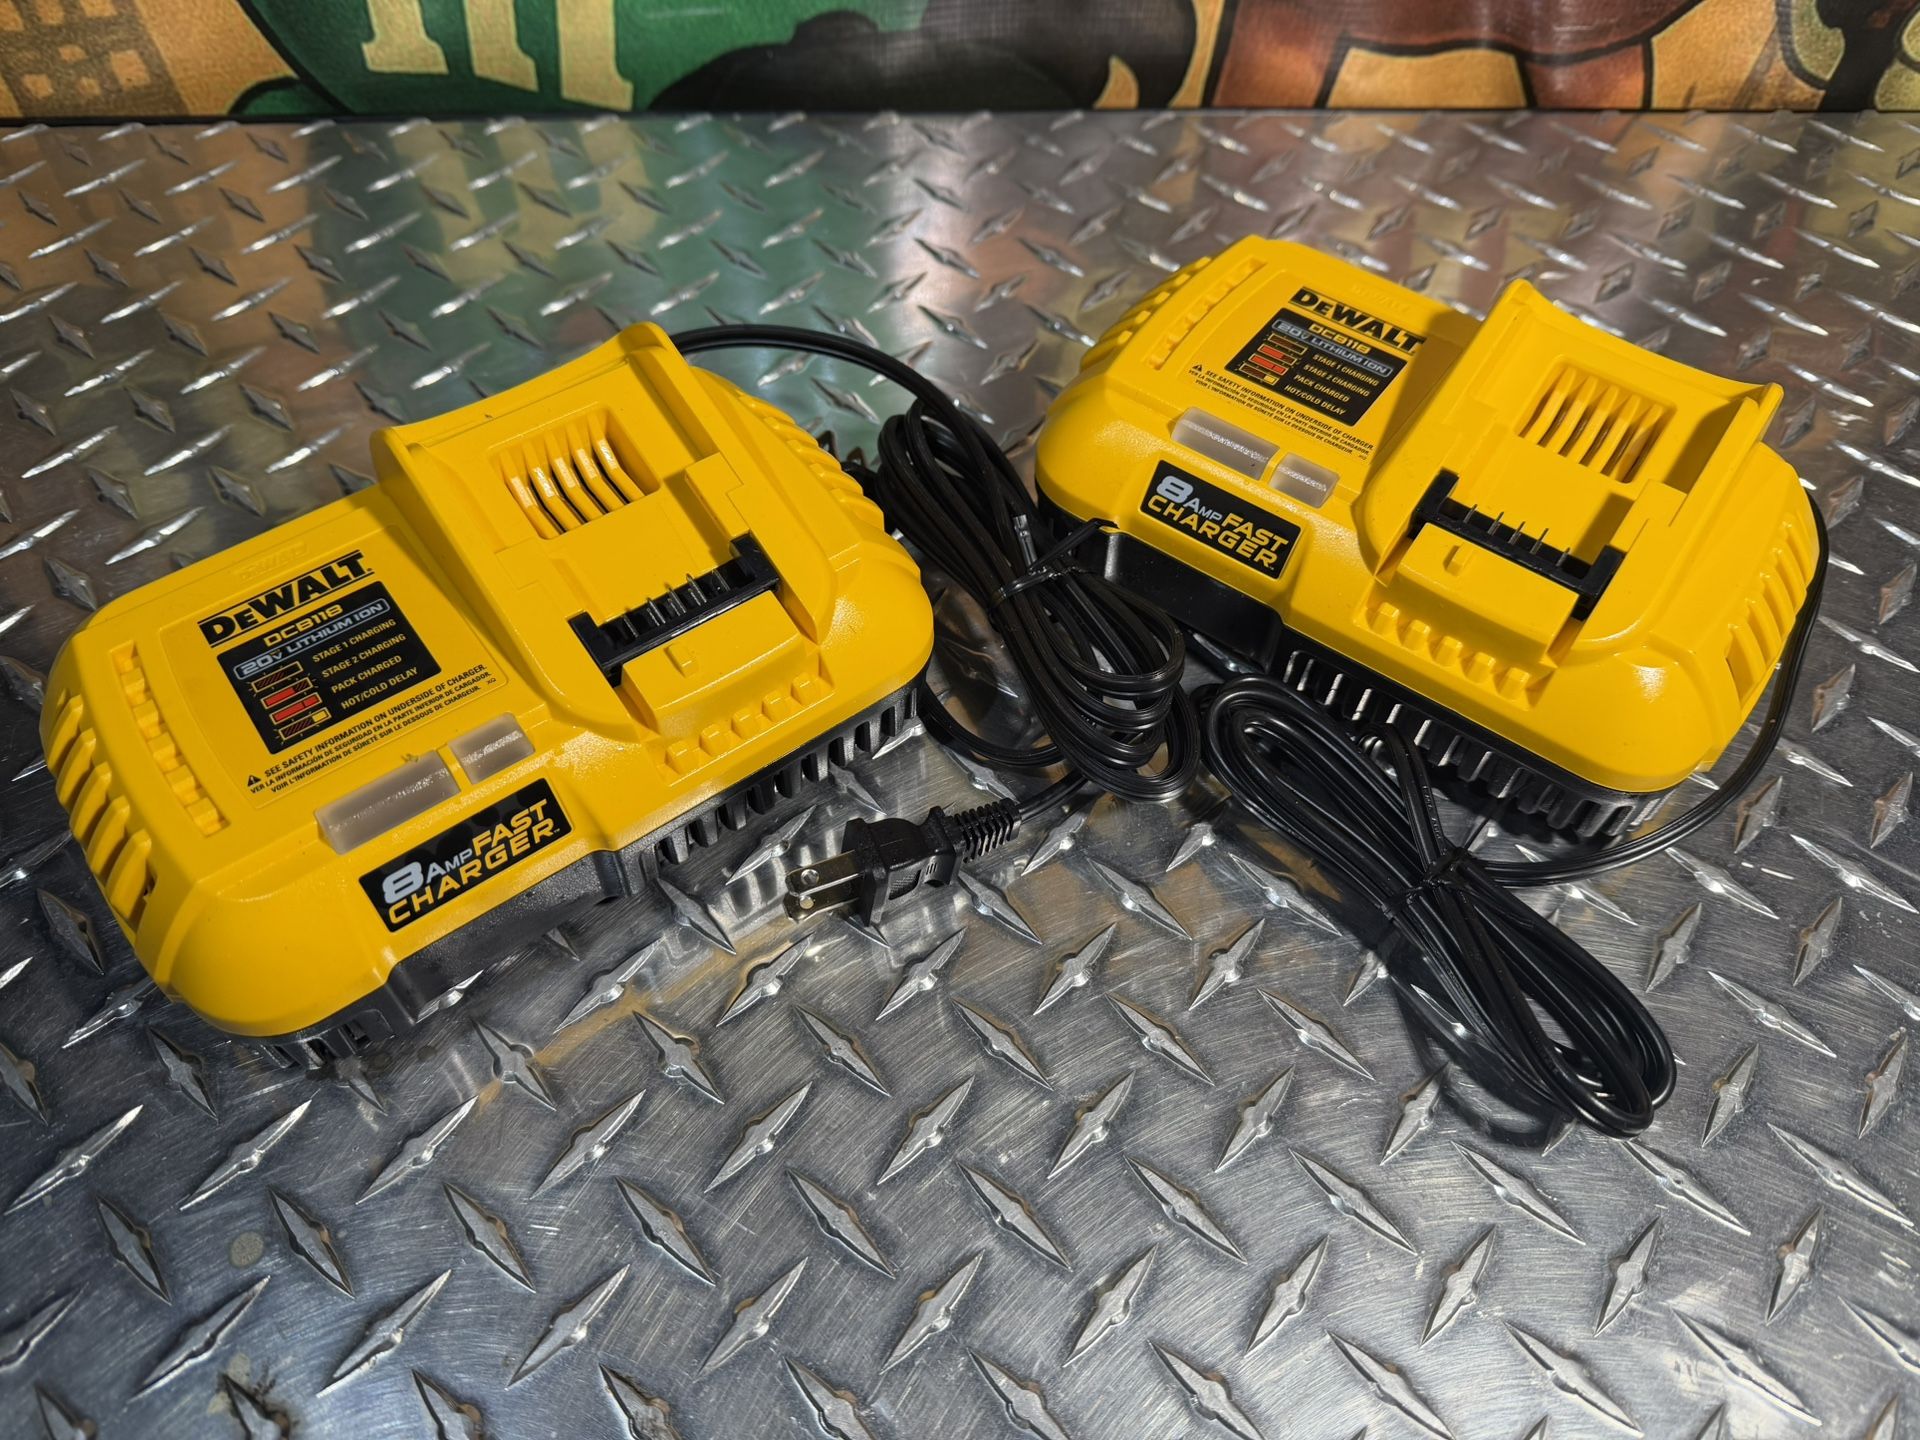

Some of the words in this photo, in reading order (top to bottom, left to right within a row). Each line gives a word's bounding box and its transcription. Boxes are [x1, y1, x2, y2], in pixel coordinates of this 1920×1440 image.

[1290, 288, 1427, 353] DEWALT
[1308, 322, 1372, 355] DCB118
[1311, 335, 1364, 364] LITHIUM
[1363, 360, 1388, 374] ION
[1312, 354, 1337, 368] STAGE
[1341, 366, 1380, 387] CHARGING
[1205, 370, 1219, 379] SEE
[1219, 375, 1242, 389] SAFETY
[1241, 386, 1285, 410] INFORMATION
[1284, 404, 1296, 414] ON
[1296, 411, 1332, 432] UNDERSIDE
[1284, 384, 1321, 405] HOT/COLD
[1320, 400, 1347, 416] DELAY
[1293, 374, 1315, 387] PACK
[1314, 383, 1351, 403] CHARGED
[1303, 364, 1327, 378] STAGE
[1331, 376, 1371, 397] CHARGING
[1147, 494, 1278, 568] CHARGER
[1156, 475, 1194, 504] 8
[1183, 497, 1223, 522] AMP
[1221, 512, 1289, 552] FAST
[198, 551, 368, 646] DEWALT
[263, 604, 344, 647] DCB118
[286, 617, 353, 653] LITHIUM
[351, 603, 383, 622] ION
[312, 644, 342, 663] STAGE
[349, 618, 397, 645] CHARGING
[321, 658, 353, 678] STAGE
[352, 656, 359, 664] 2
[358, 633, 407, 660] CHARGING
[331, 676, 358, 694] PACK
[357, 655, 402, 681] CHARGED
[340, 682, 388, 710] HOT/COLD
[388, 666, 418, 686] DELAY
[250, 782, 265, 794] VER
[265, 779, 275, 787] LA
[275, 755, 324, 782] INFORMACIÓN
[324, 749, 334, 757] DE
[334, 729, 373, 752] SEGURIDAD
[373, 722, 384, 733] EN
[383, 719, 393, 728] LA
[393, 710, 414, 723] PARTE
[415, 694, 445, 712] INFERIOR
[445, 689, 454, 697] DE
[264, 766, 282, 778] SEE
[282, 748, 313, 769] SAFETY
[315, 718, 373, 753] INFORMATION
[373, 711, 387, 723] ON
[387, 689, 435, 716] UNDERSIDE
[434, 682, 446, 693] OF
[270, 781, 289, 793] VOIR
[342, 749, 353, 757] DE
[379, 728, 394, 739] SUR
[394, 723, 403, 731] LE
[403, 708, 434, 727] DESSOUS
[434, 703, 443, 711] DE
[382, 861, 424, 905] 8
[426, 848, 473, 884] AMP
[472, 798, 548, 856] FAST
[388, 817, 555, 925] CHARGER
